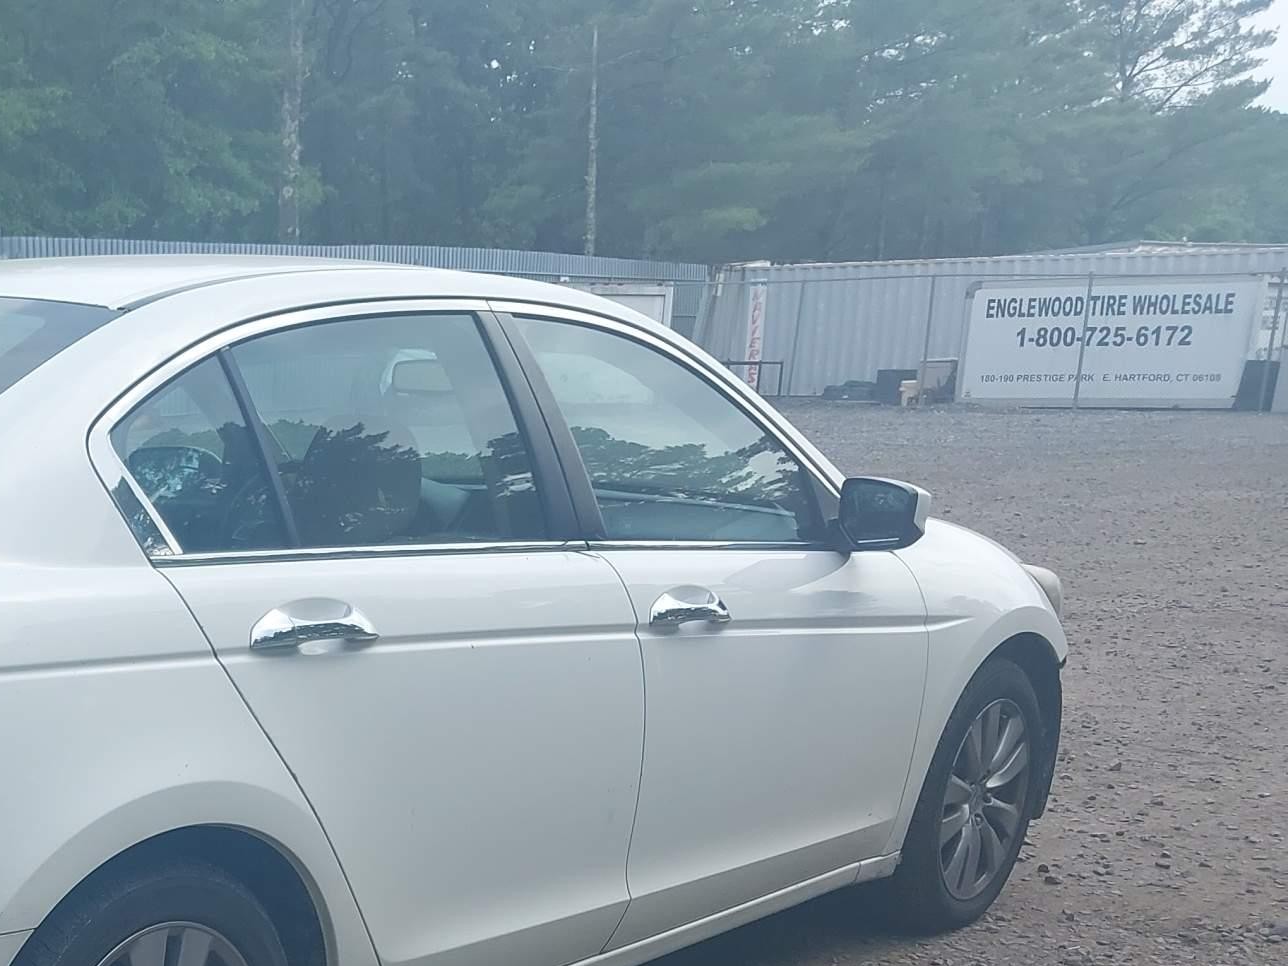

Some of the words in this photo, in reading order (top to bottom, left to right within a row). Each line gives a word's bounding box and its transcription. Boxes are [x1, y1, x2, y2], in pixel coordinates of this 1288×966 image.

[985, 296, 1085, 319] ENGLEWOOD
[1091, 294, 1128, 317] TIRE
[1132, 293, 1236, 316] WHOLESALE
[1016, 325, 1193, 347] 1-800-725-6172
[1016, 374, 1065, 383] PRESTIGE
[1175, 373, 1191, 382] CT
